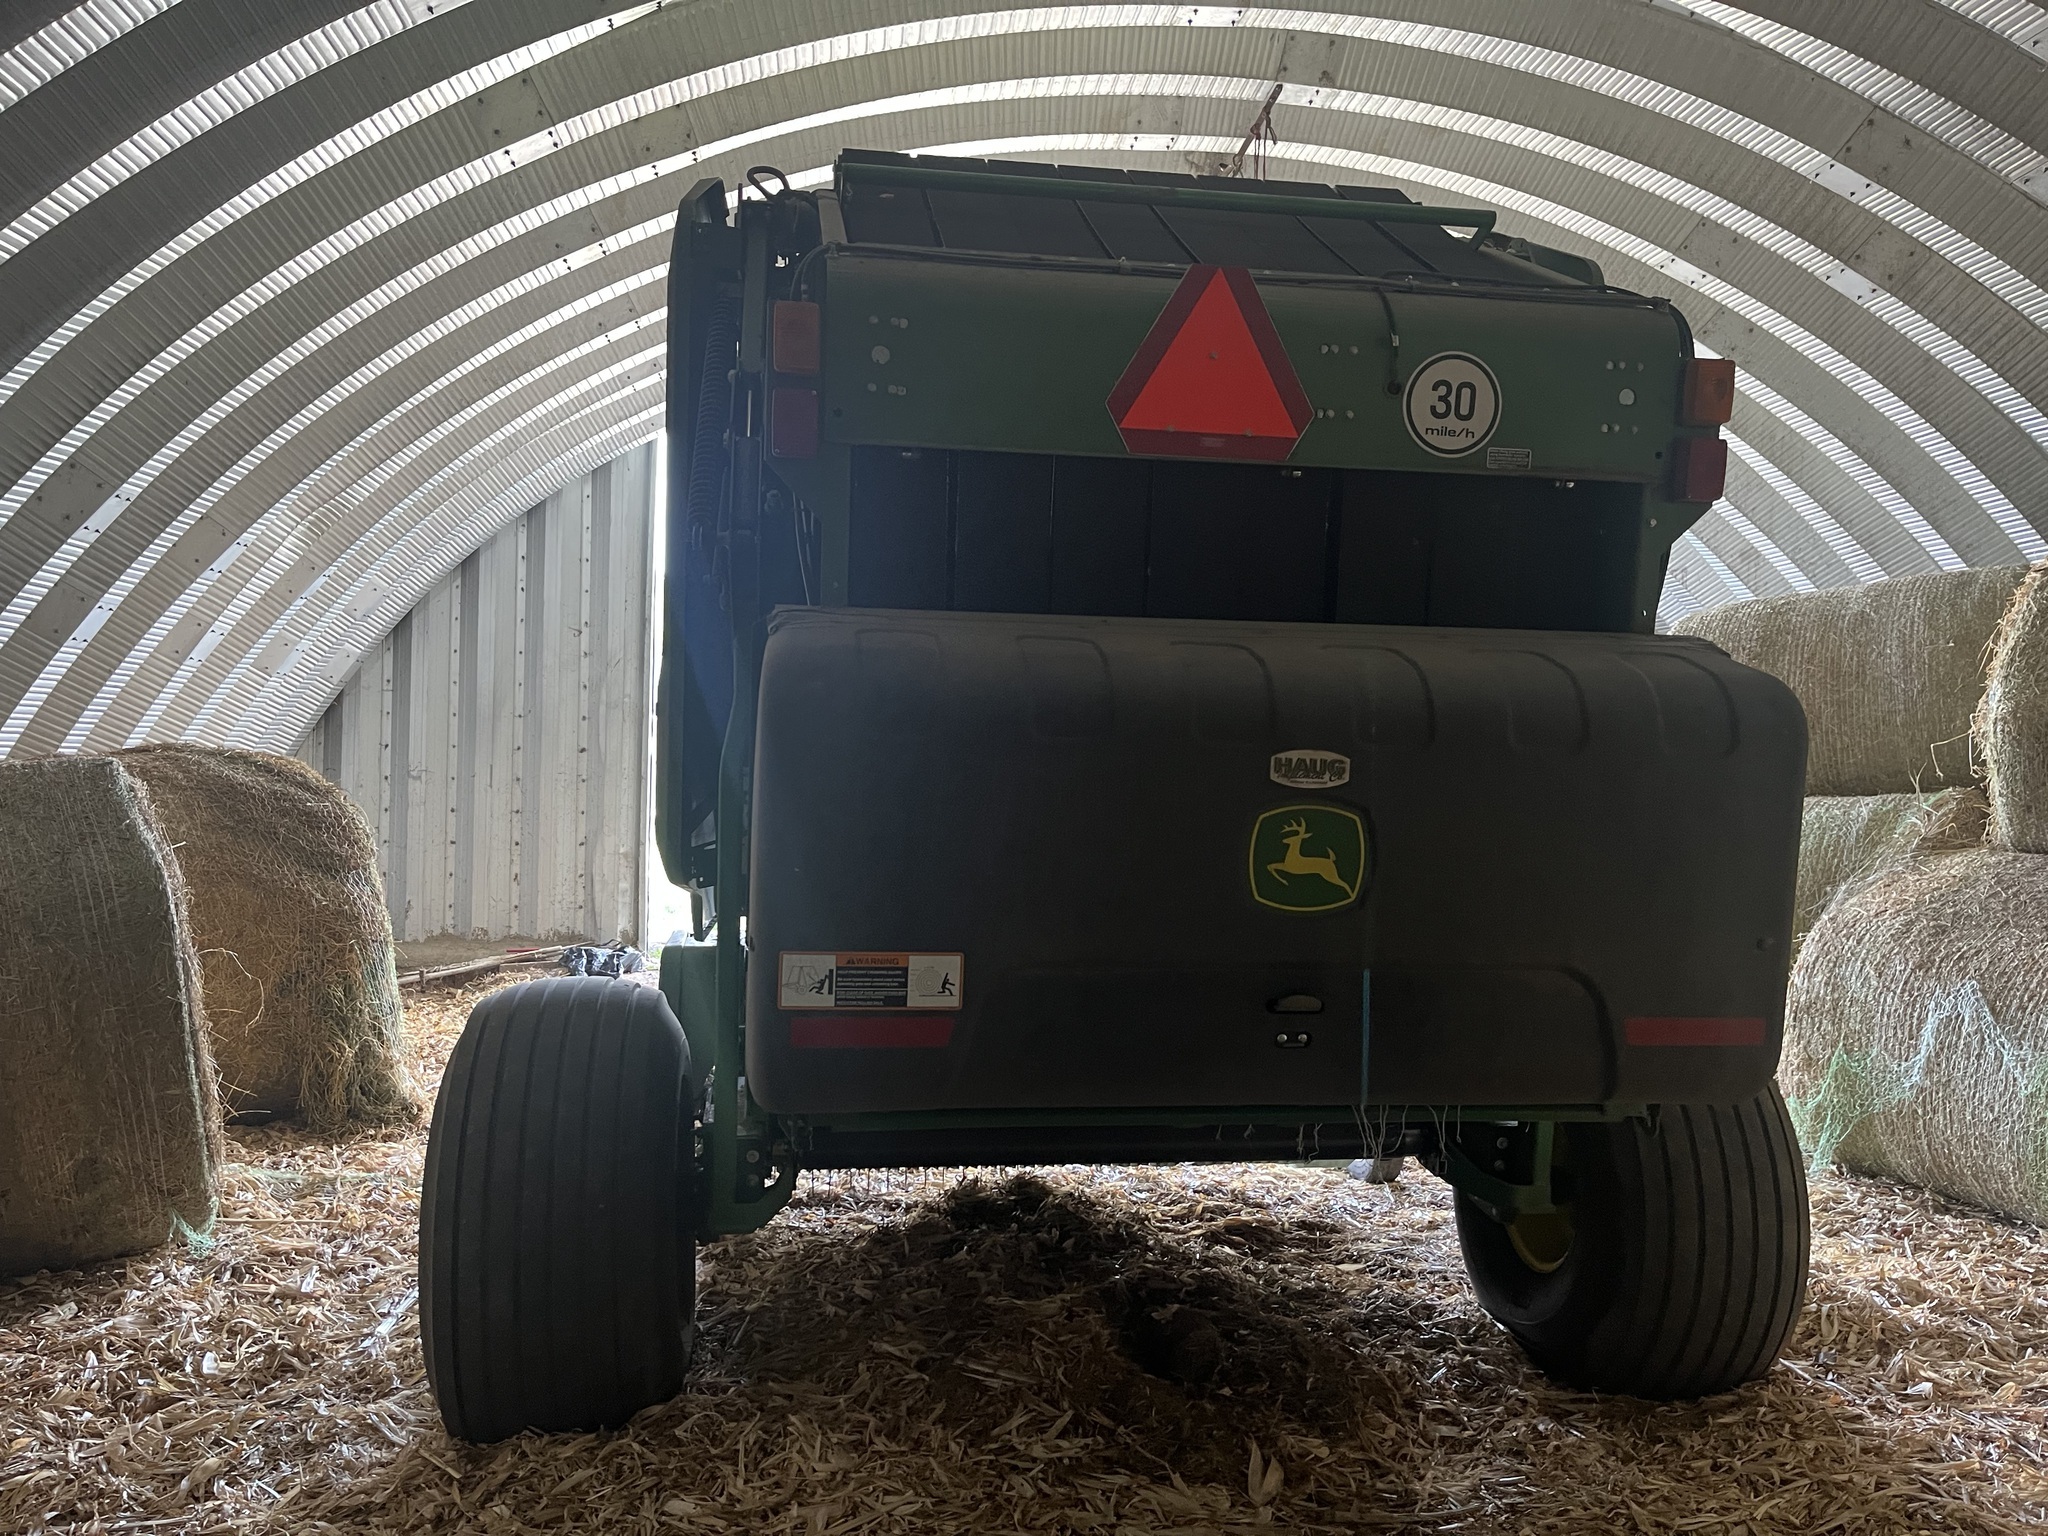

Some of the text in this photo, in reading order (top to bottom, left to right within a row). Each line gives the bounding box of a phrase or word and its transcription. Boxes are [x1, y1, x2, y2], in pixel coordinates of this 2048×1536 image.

[1430, 379, 1477, 422] 30
[1425, 426, 1475, 439] mile/h
[1273, 757, 1347, 776] HAUG
[855, 957, 900, 965] WARNING
